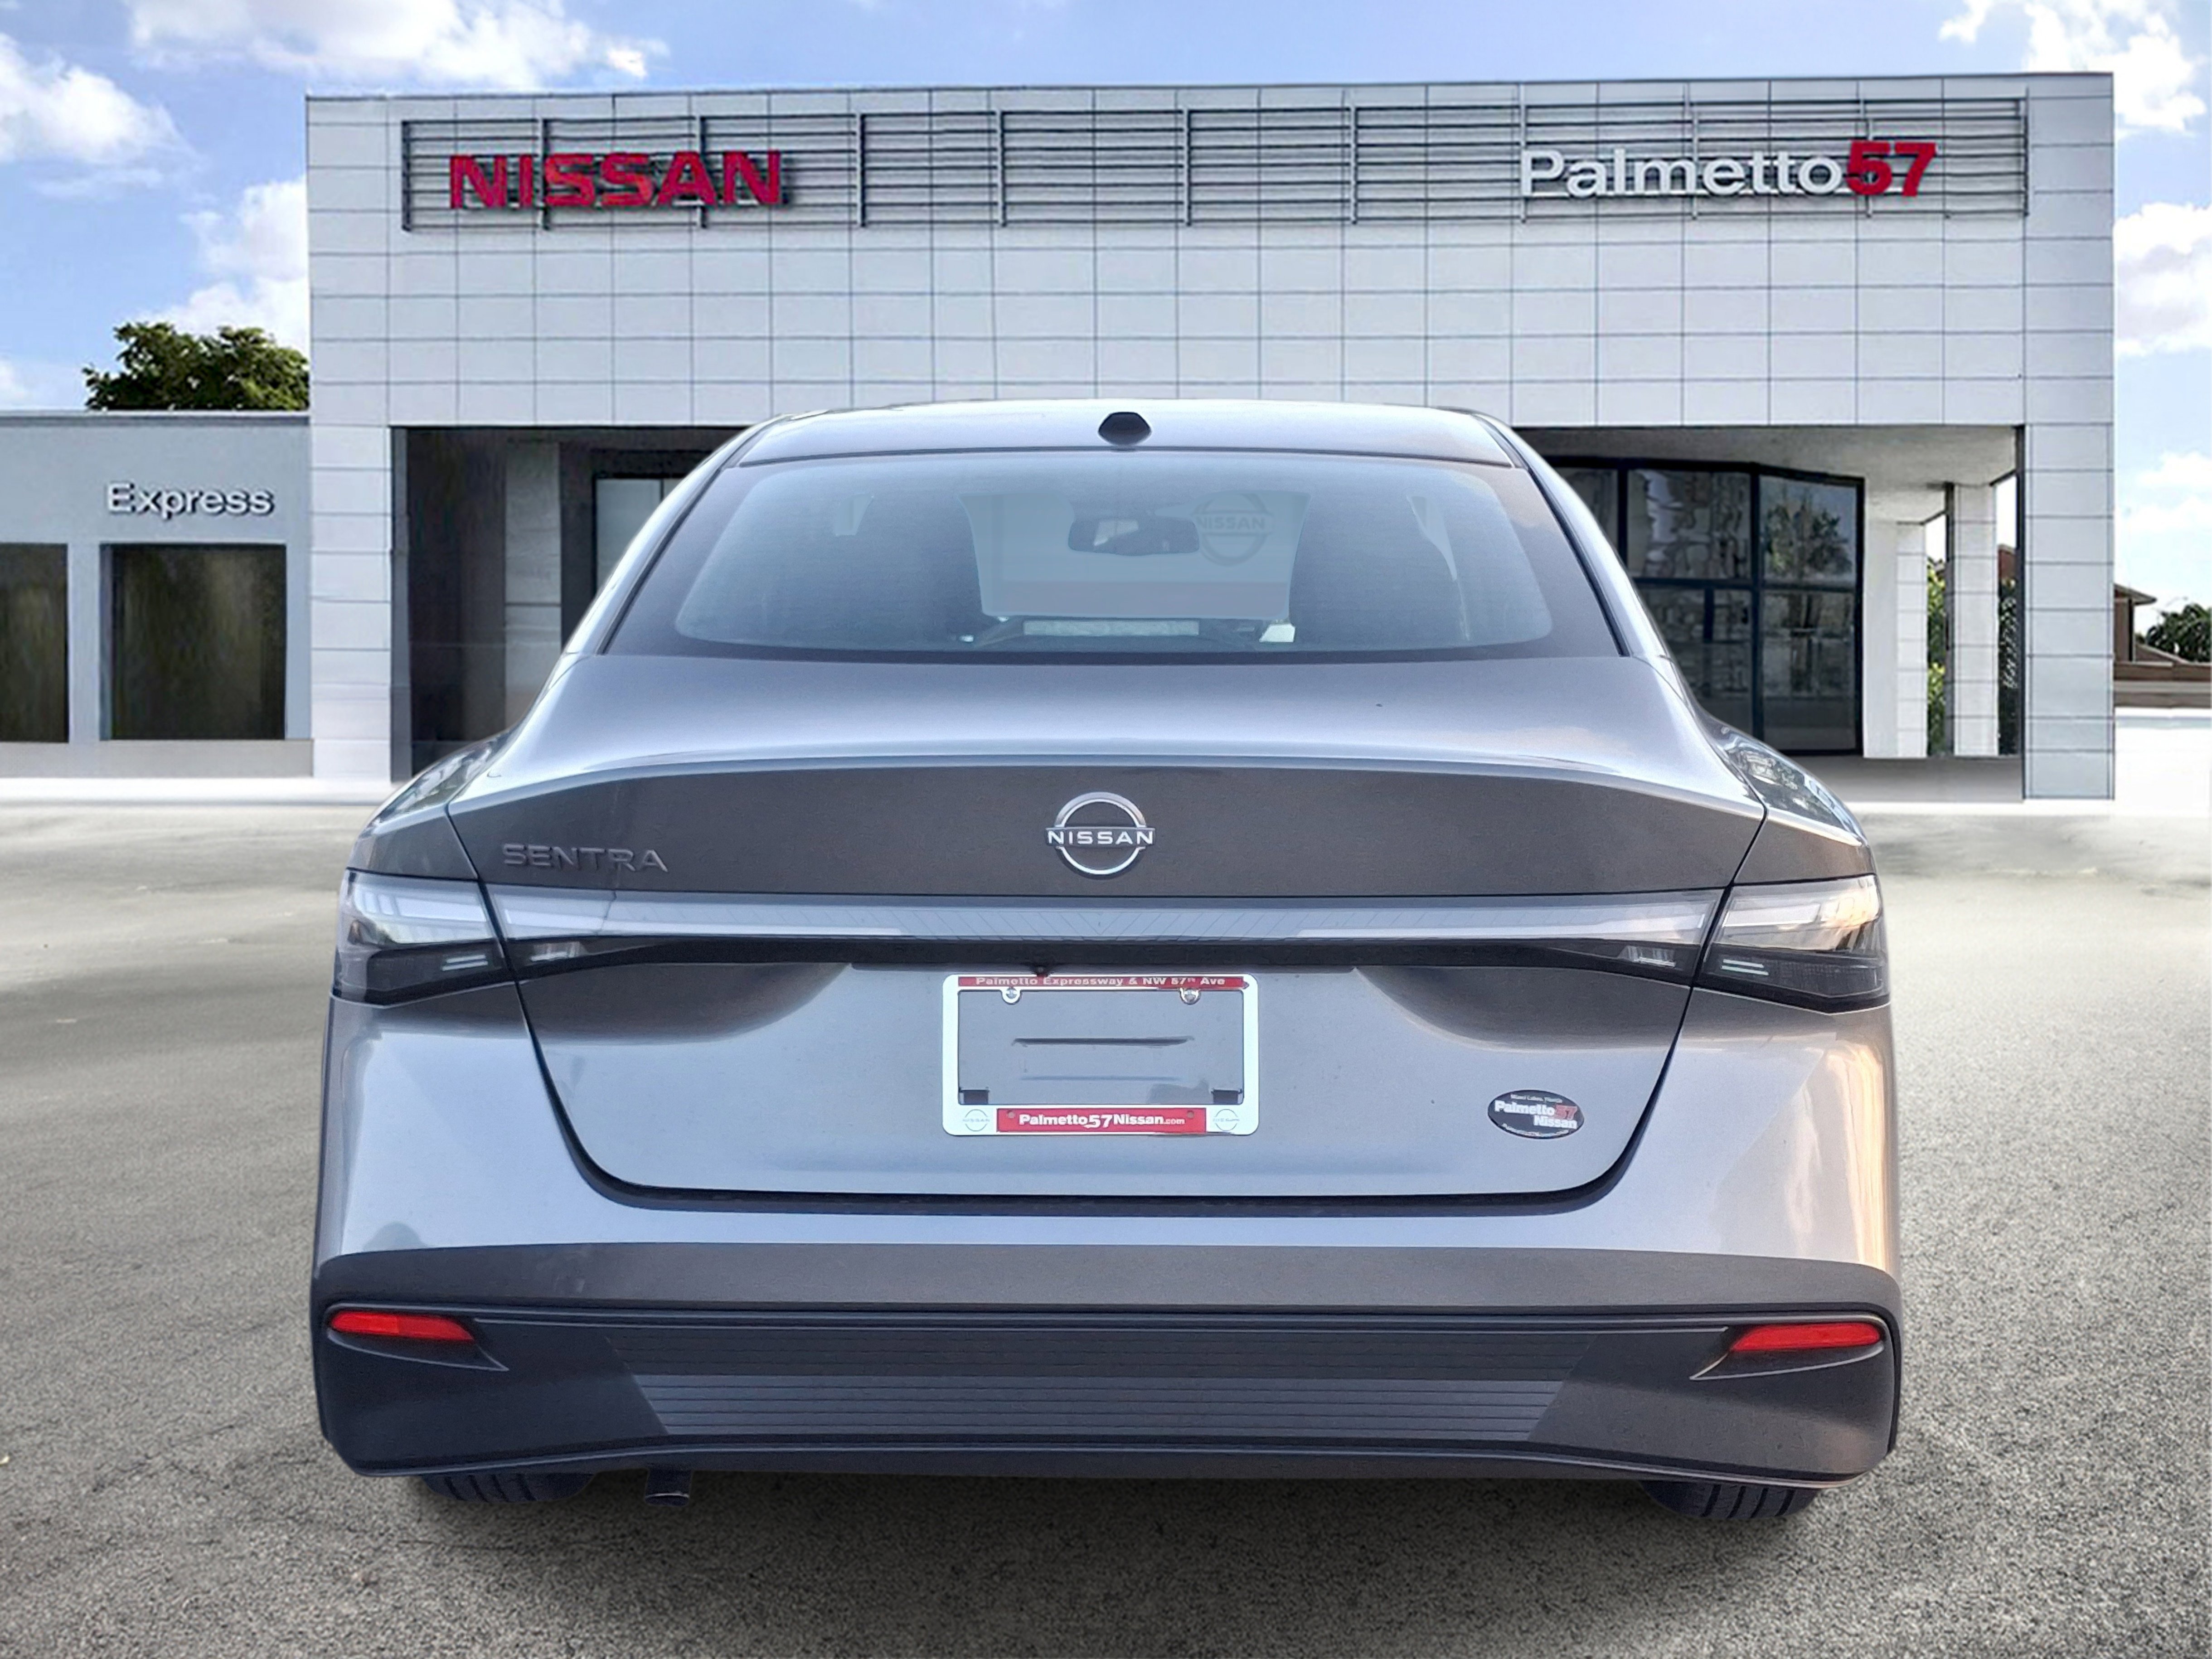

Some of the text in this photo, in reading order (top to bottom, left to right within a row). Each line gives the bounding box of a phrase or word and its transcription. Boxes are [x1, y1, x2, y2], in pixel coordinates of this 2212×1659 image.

[450, 150, 781, 209] NISSAN
[107, 483, 274, 520] Express
[1196, 516, 1265, 529] NISSAN
[1048, 830, 1153, 845] NISSAN
[503, 844, 669, 873] SENTRA
[975, 977, 1038, 985] Palmetto
[1043, 977, 1123, 986] Expressway
[1200, 977, 1225, 985] Ave
[1019, 1114, 1185, 1129] Palmetto57Nissan.com
[1533, 1115, 1577, 1130] Nissan
